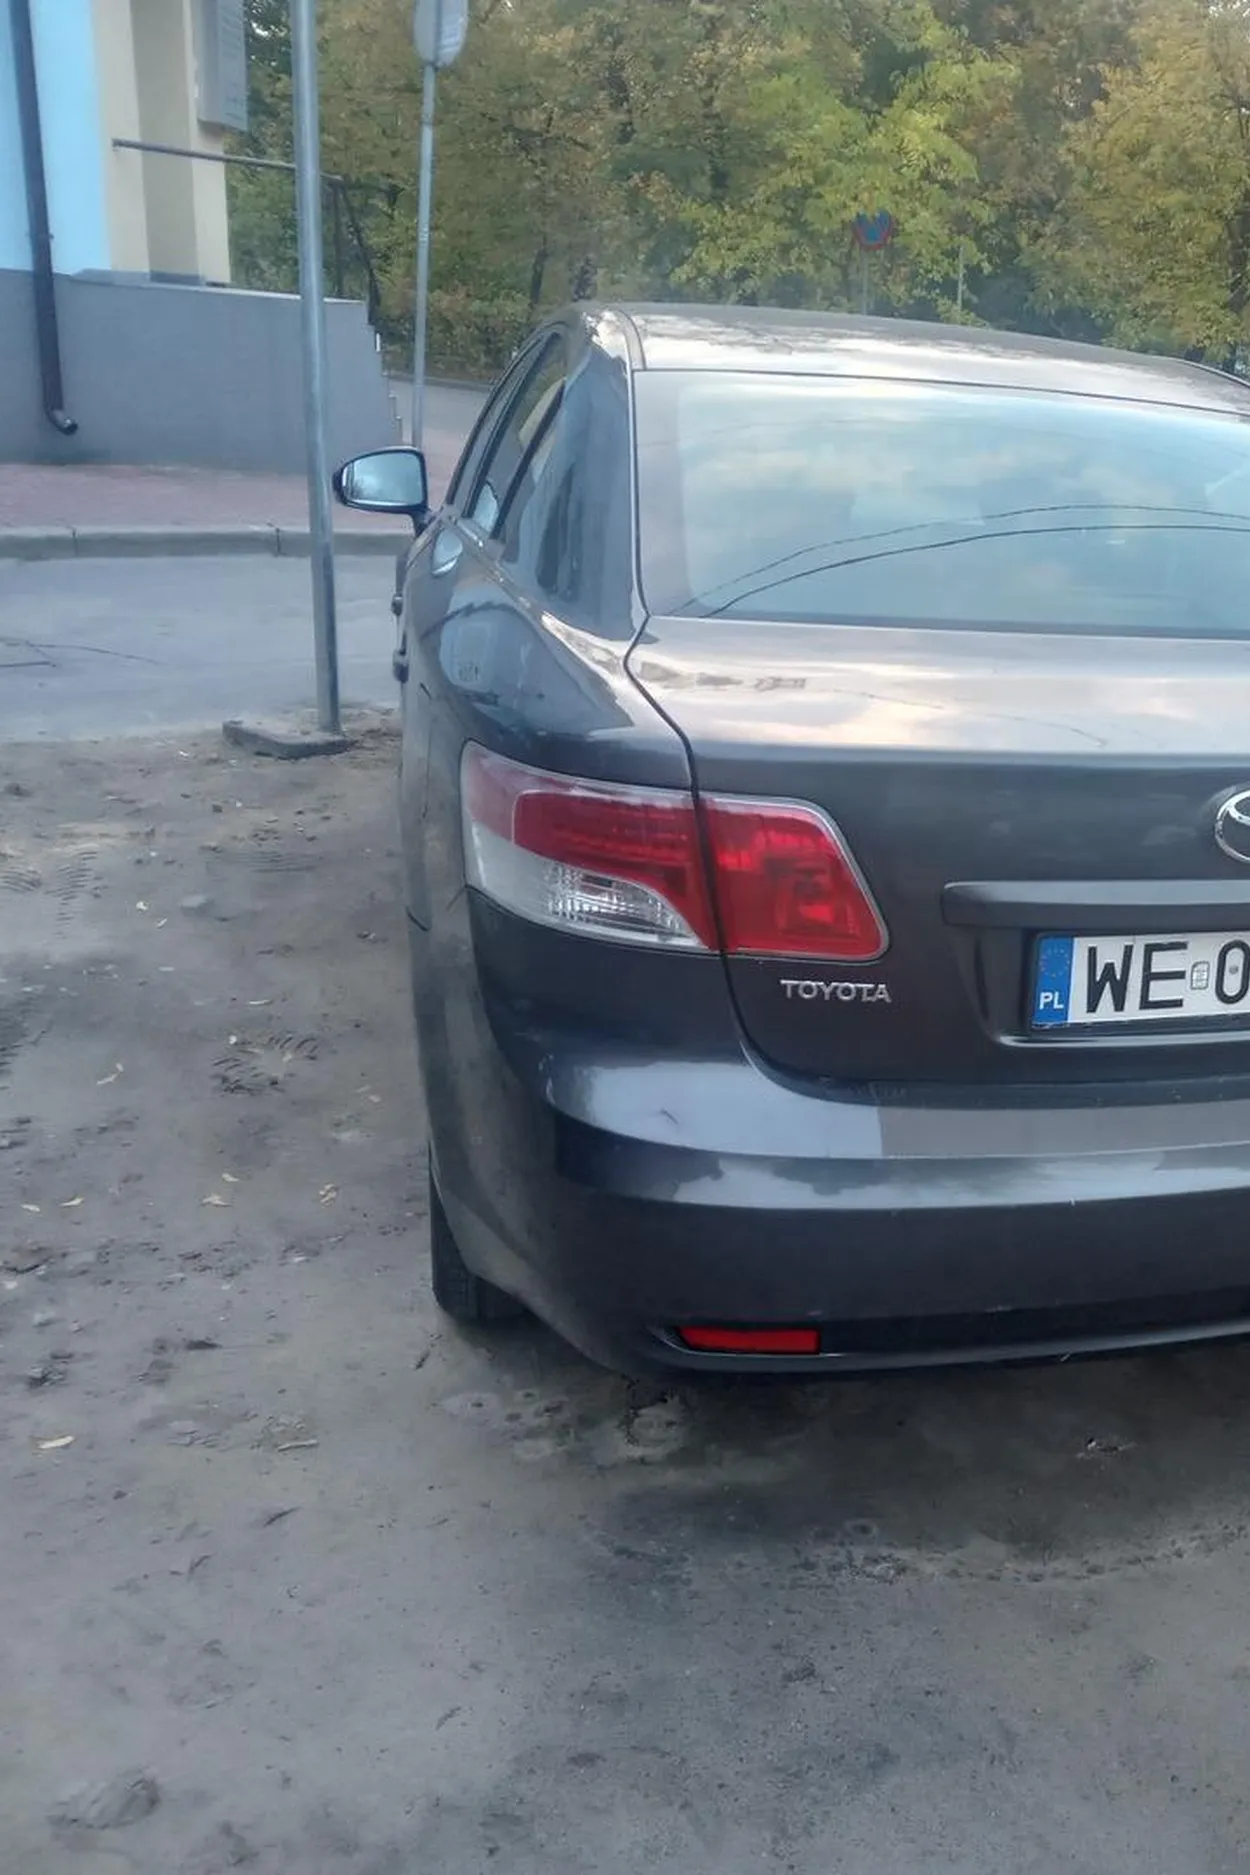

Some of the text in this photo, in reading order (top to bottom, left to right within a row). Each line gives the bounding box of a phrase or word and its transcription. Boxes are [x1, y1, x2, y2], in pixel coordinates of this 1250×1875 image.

[1086, 941, 1188, 1014] WE
[780, 979, 892, 1003] TOYOTA
[1039, 991, 1065, 1010] PL
